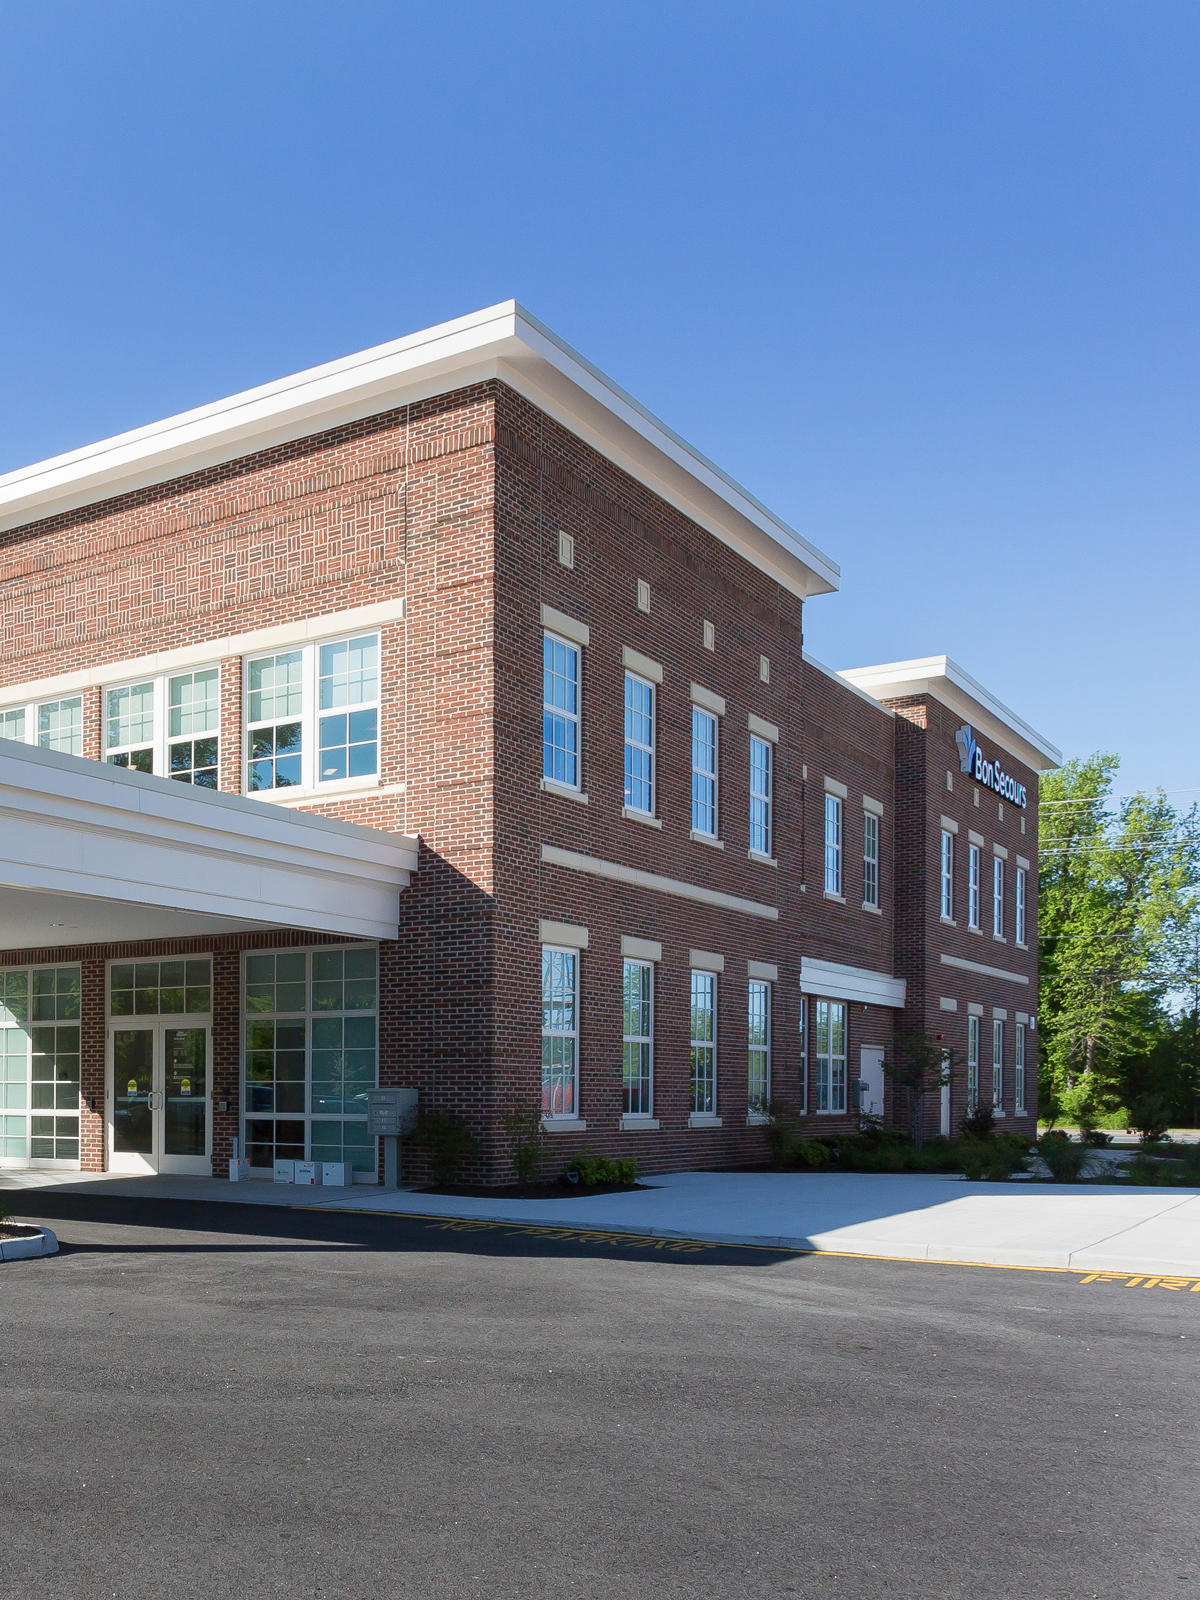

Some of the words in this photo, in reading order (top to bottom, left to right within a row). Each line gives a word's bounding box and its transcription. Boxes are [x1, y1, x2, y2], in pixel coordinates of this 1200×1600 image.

[975, 746, 994, 788] Bon
[994, 760, 1027, 808] Secours
[423, 1221, 499, 1232] NO
[504, 1228, 717, 1252] PARKING
